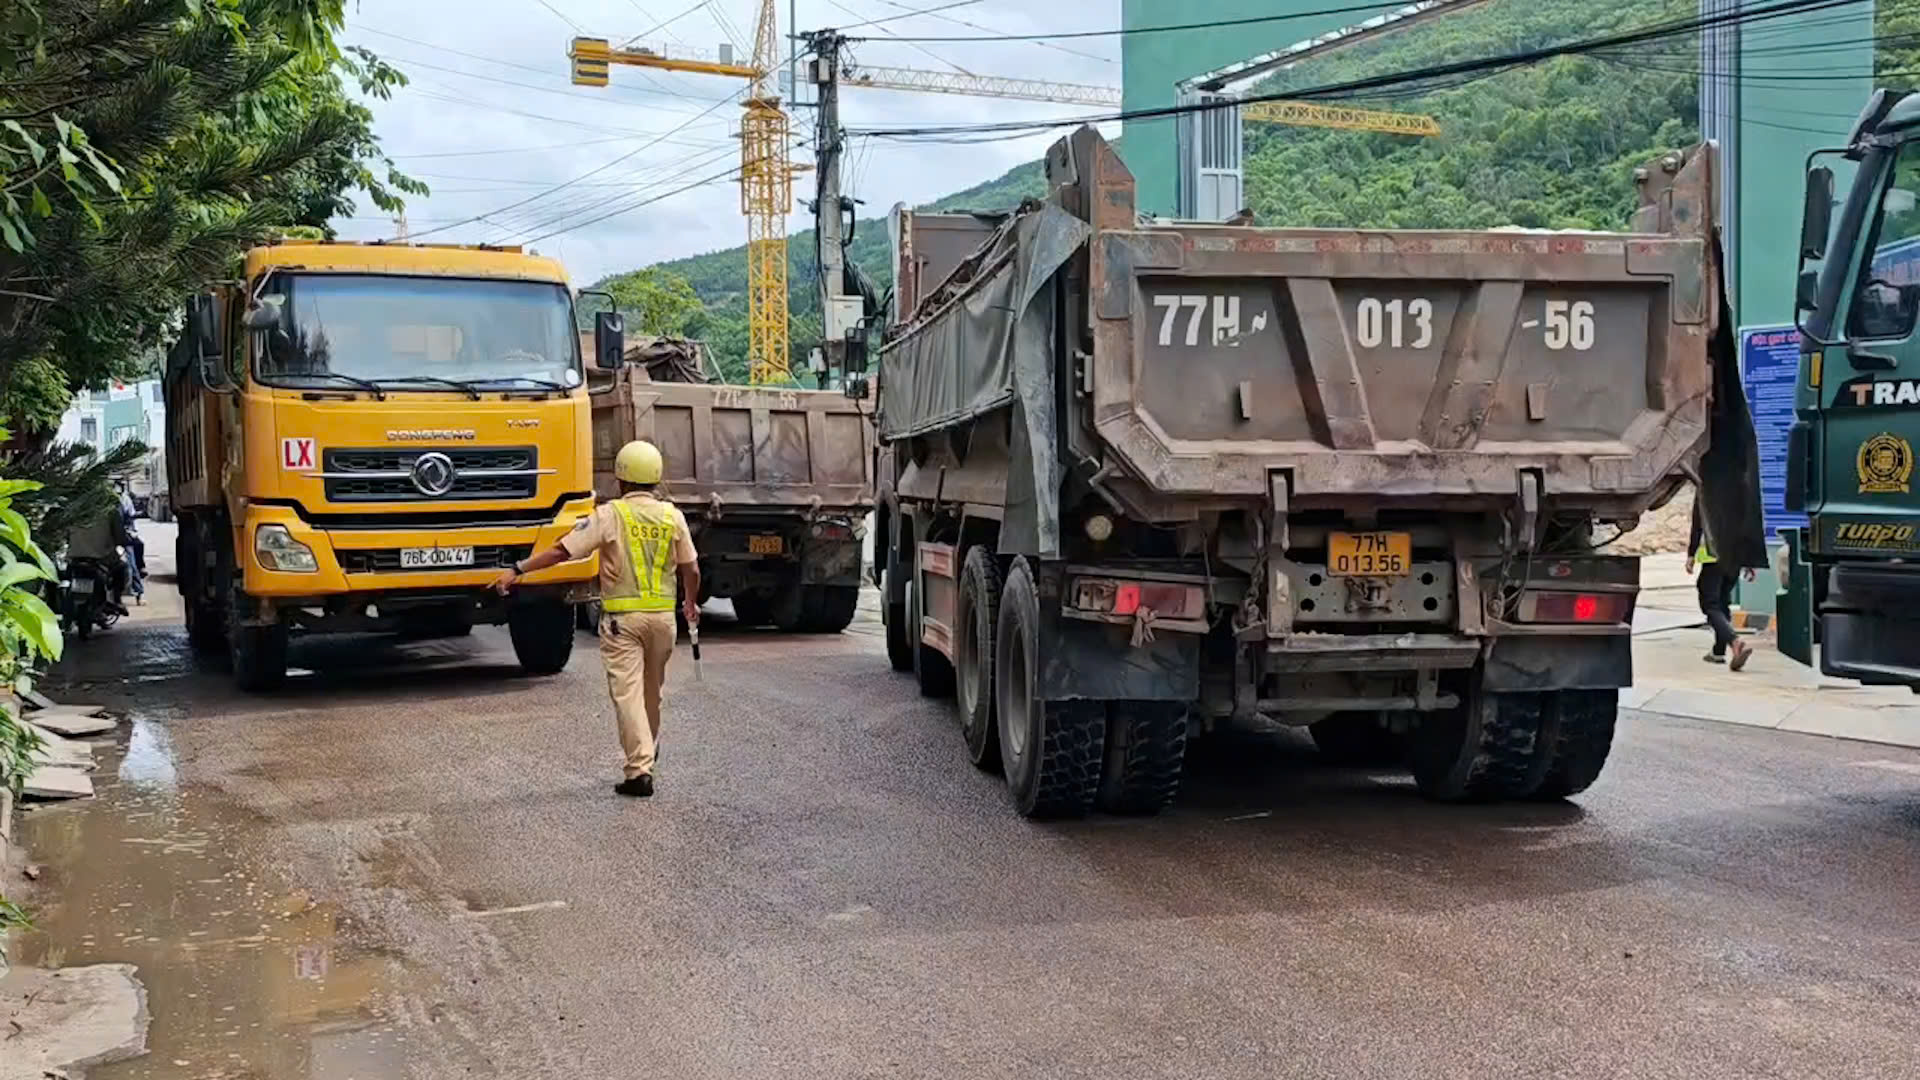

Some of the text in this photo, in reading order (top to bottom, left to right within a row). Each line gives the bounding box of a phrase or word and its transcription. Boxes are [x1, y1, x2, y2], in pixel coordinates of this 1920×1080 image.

[1356, 297, 1434, 349] 013
[1849, 381, 1920, 406] TRA
[385, 429, 476, 441] DONGFENG
[284, 439, 313, 467] LX
[630, 525, 669, 540] CSGT
[1835, 522, 1914, 546] TURBO
[1351, 535, 1388, 553] 77H
[1337, 554, 1401, 573] 013.56
